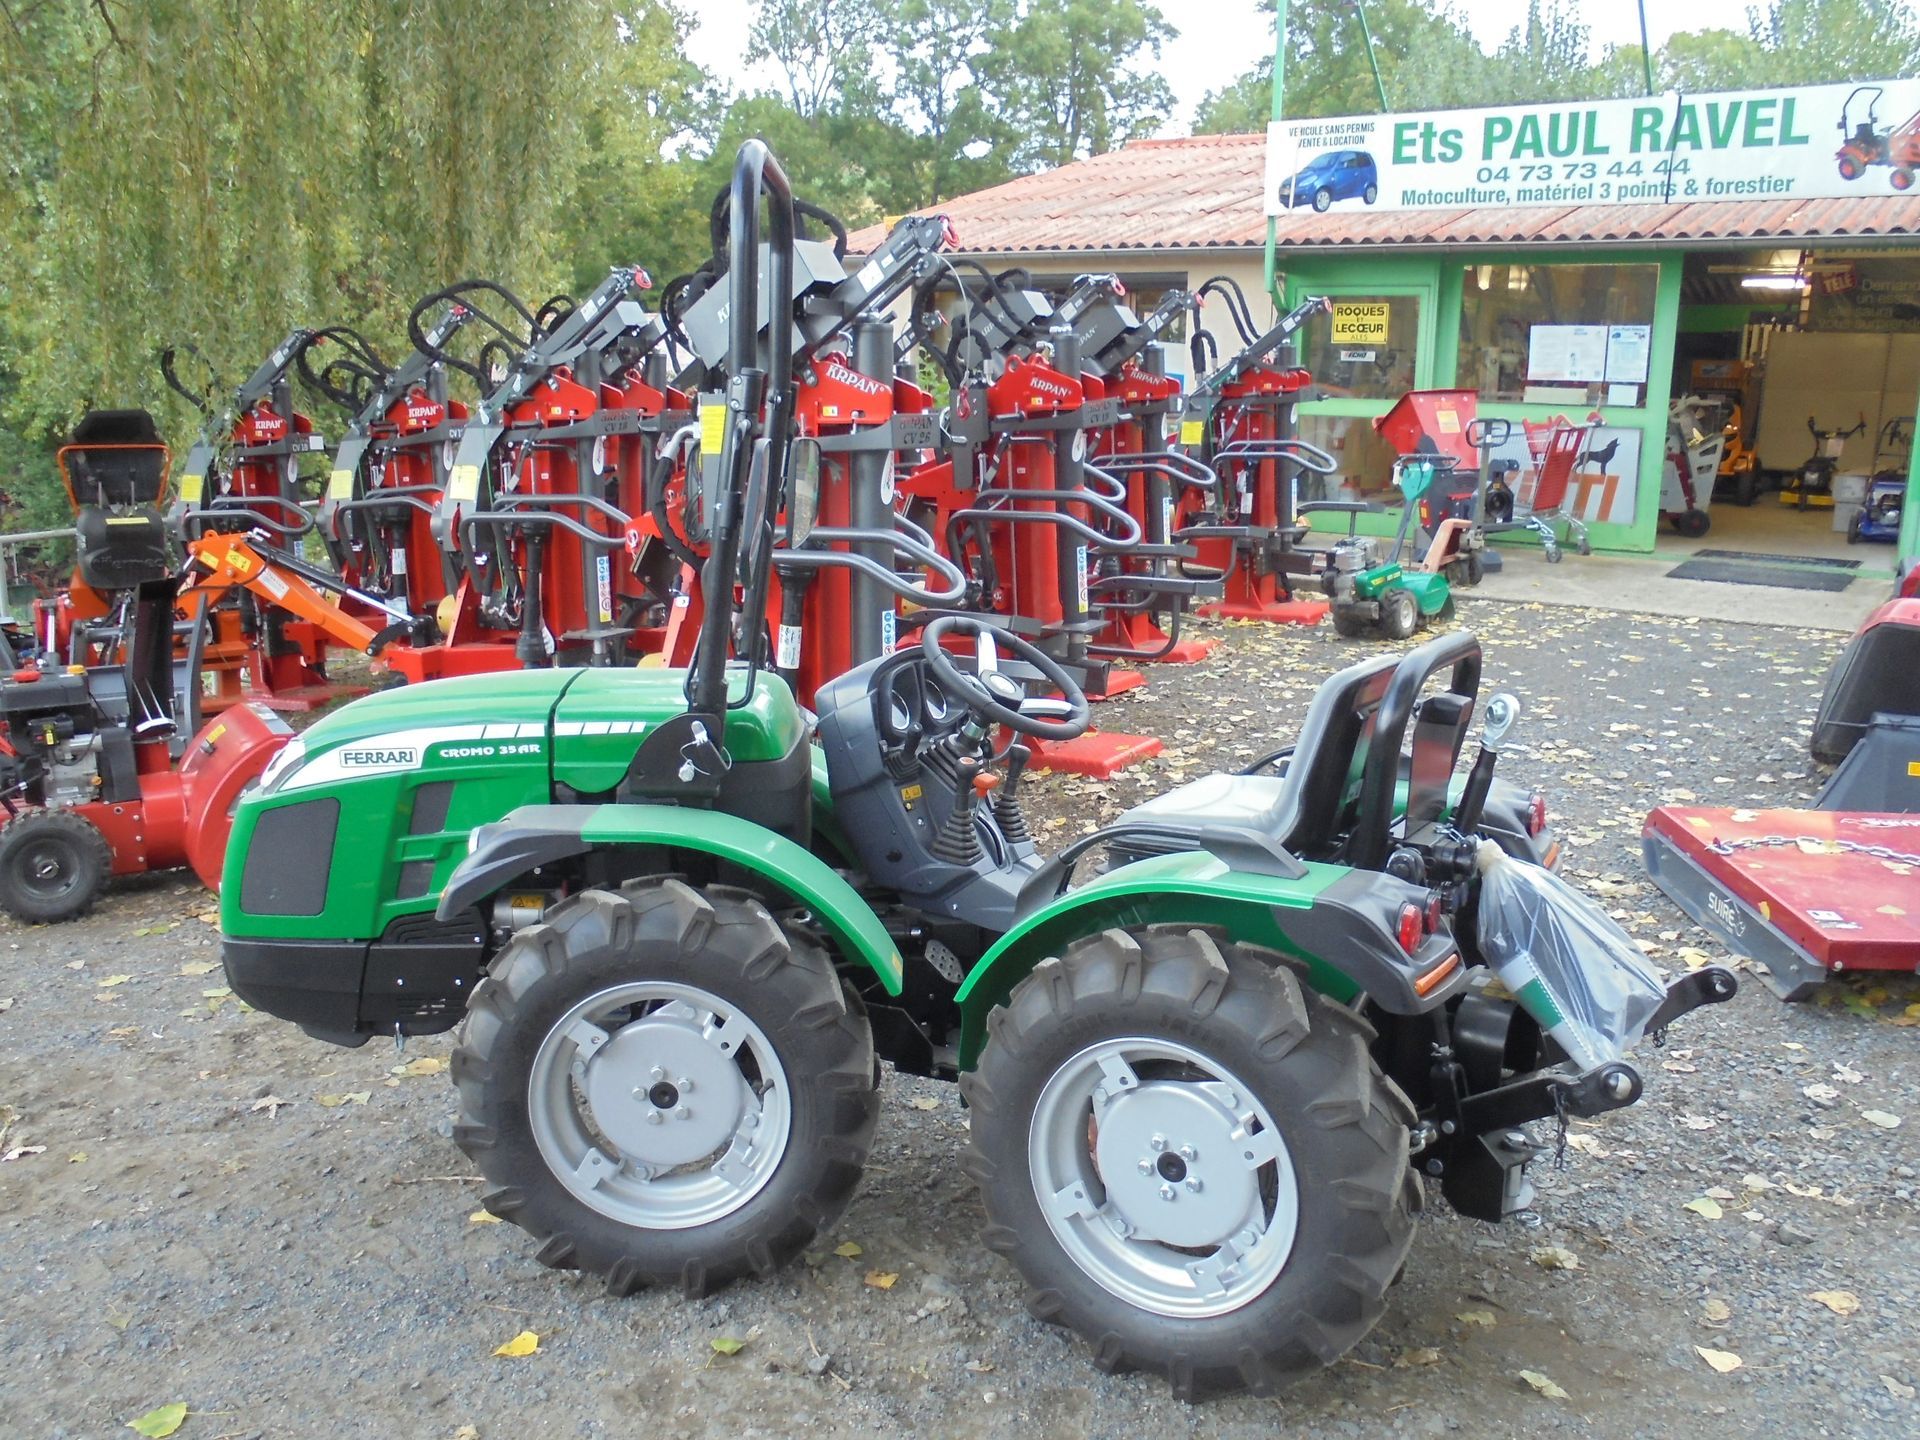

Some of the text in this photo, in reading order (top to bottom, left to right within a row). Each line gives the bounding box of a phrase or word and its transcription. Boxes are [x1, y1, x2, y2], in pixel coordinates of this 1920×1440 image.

[1324, 124, 1345, 135] SANS
[1346, 122, 1375, 133] PERMIS
[1392, 97, 1810, 165] Ets PAUL RAVEL
[1322, 136, 1328, 146] &
[1329, 135, 1365, 146] LOCATION
[1476, 158, 1690, 183] 04 73 73 44 44
[1401, 175, 1795, 206] Motoculture, matériel 3 points & forestier
[1336, 306, 1385, 317] ROQUES
[1030, 377, 1069, 397] KRPAN
[344, 750, 413, 764] FERRARI
[440, 743, 541, 757] CROMO 35 AR
[1708, 891, 1737, 928] SUIRE
